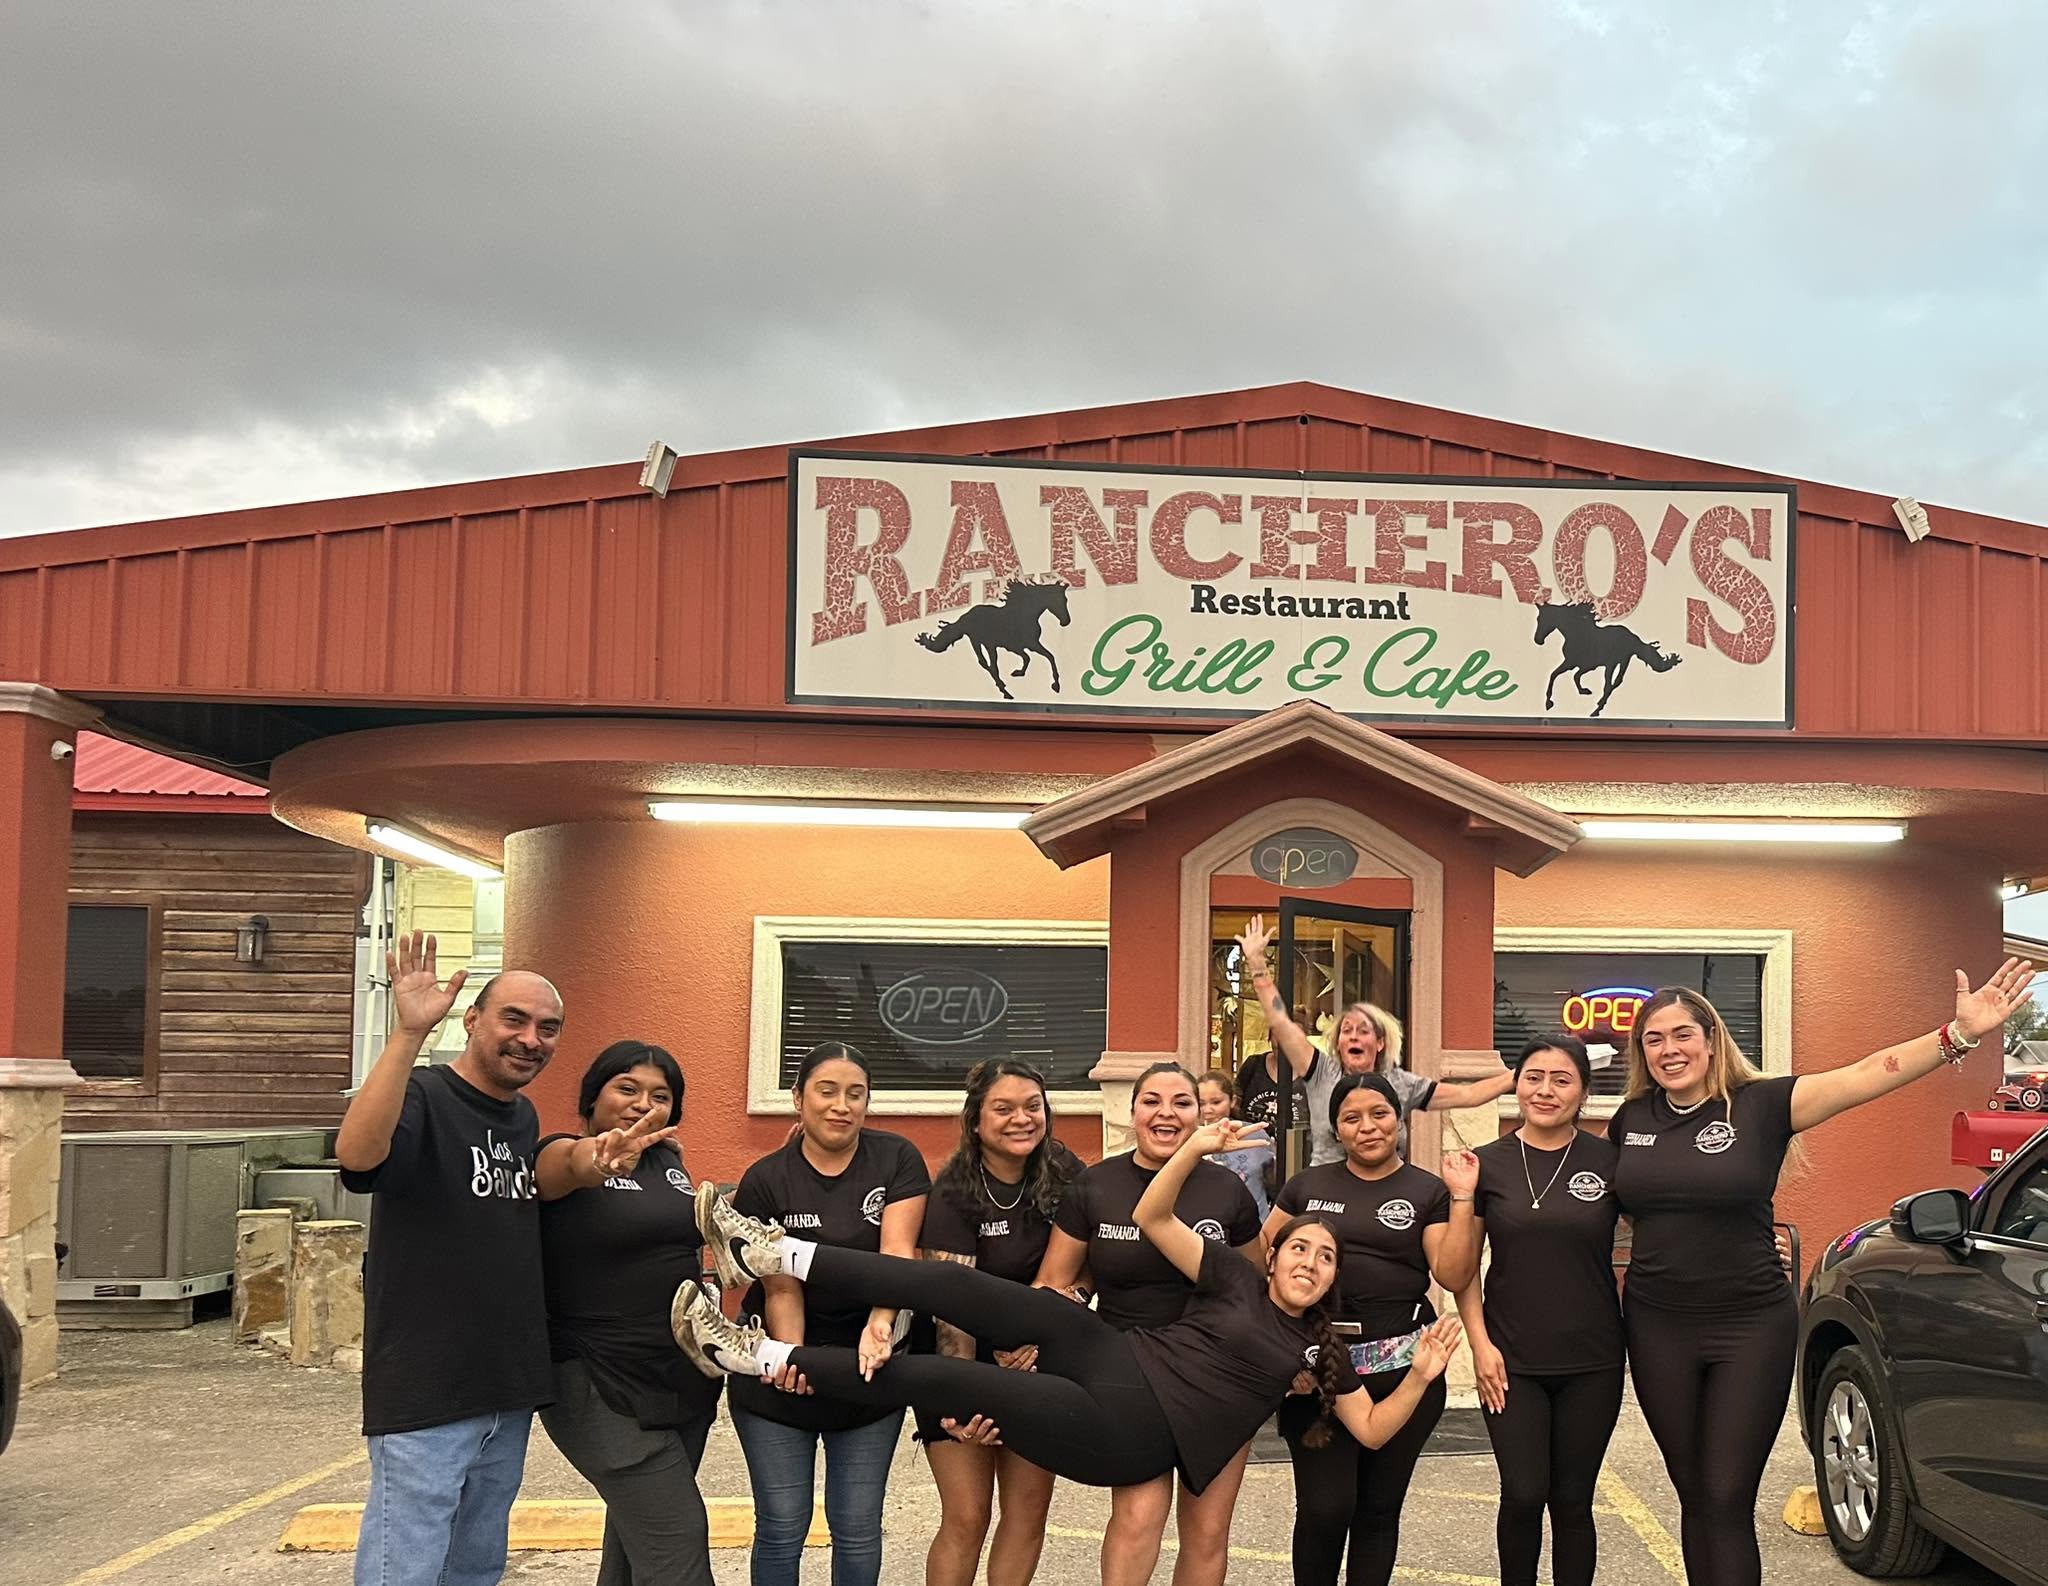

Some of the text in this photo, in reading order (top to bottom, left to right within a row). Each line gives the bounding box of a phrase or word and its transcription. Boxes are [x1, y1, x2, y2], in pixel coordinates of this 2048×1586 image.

[811, 475, 1777, 665] RANCHERO'S
[1190, 584, 1411, 621] Restaurant
[1081, 614, 1519, 709] Grill & Cafe
[887, 987, 997, 1024] OPEN
[1247, 1091, 1278, 1111] AMERICA
[487, 1129, 514, 1163] Los
[1097, 1222, 1140, 1241] FERNANDA
